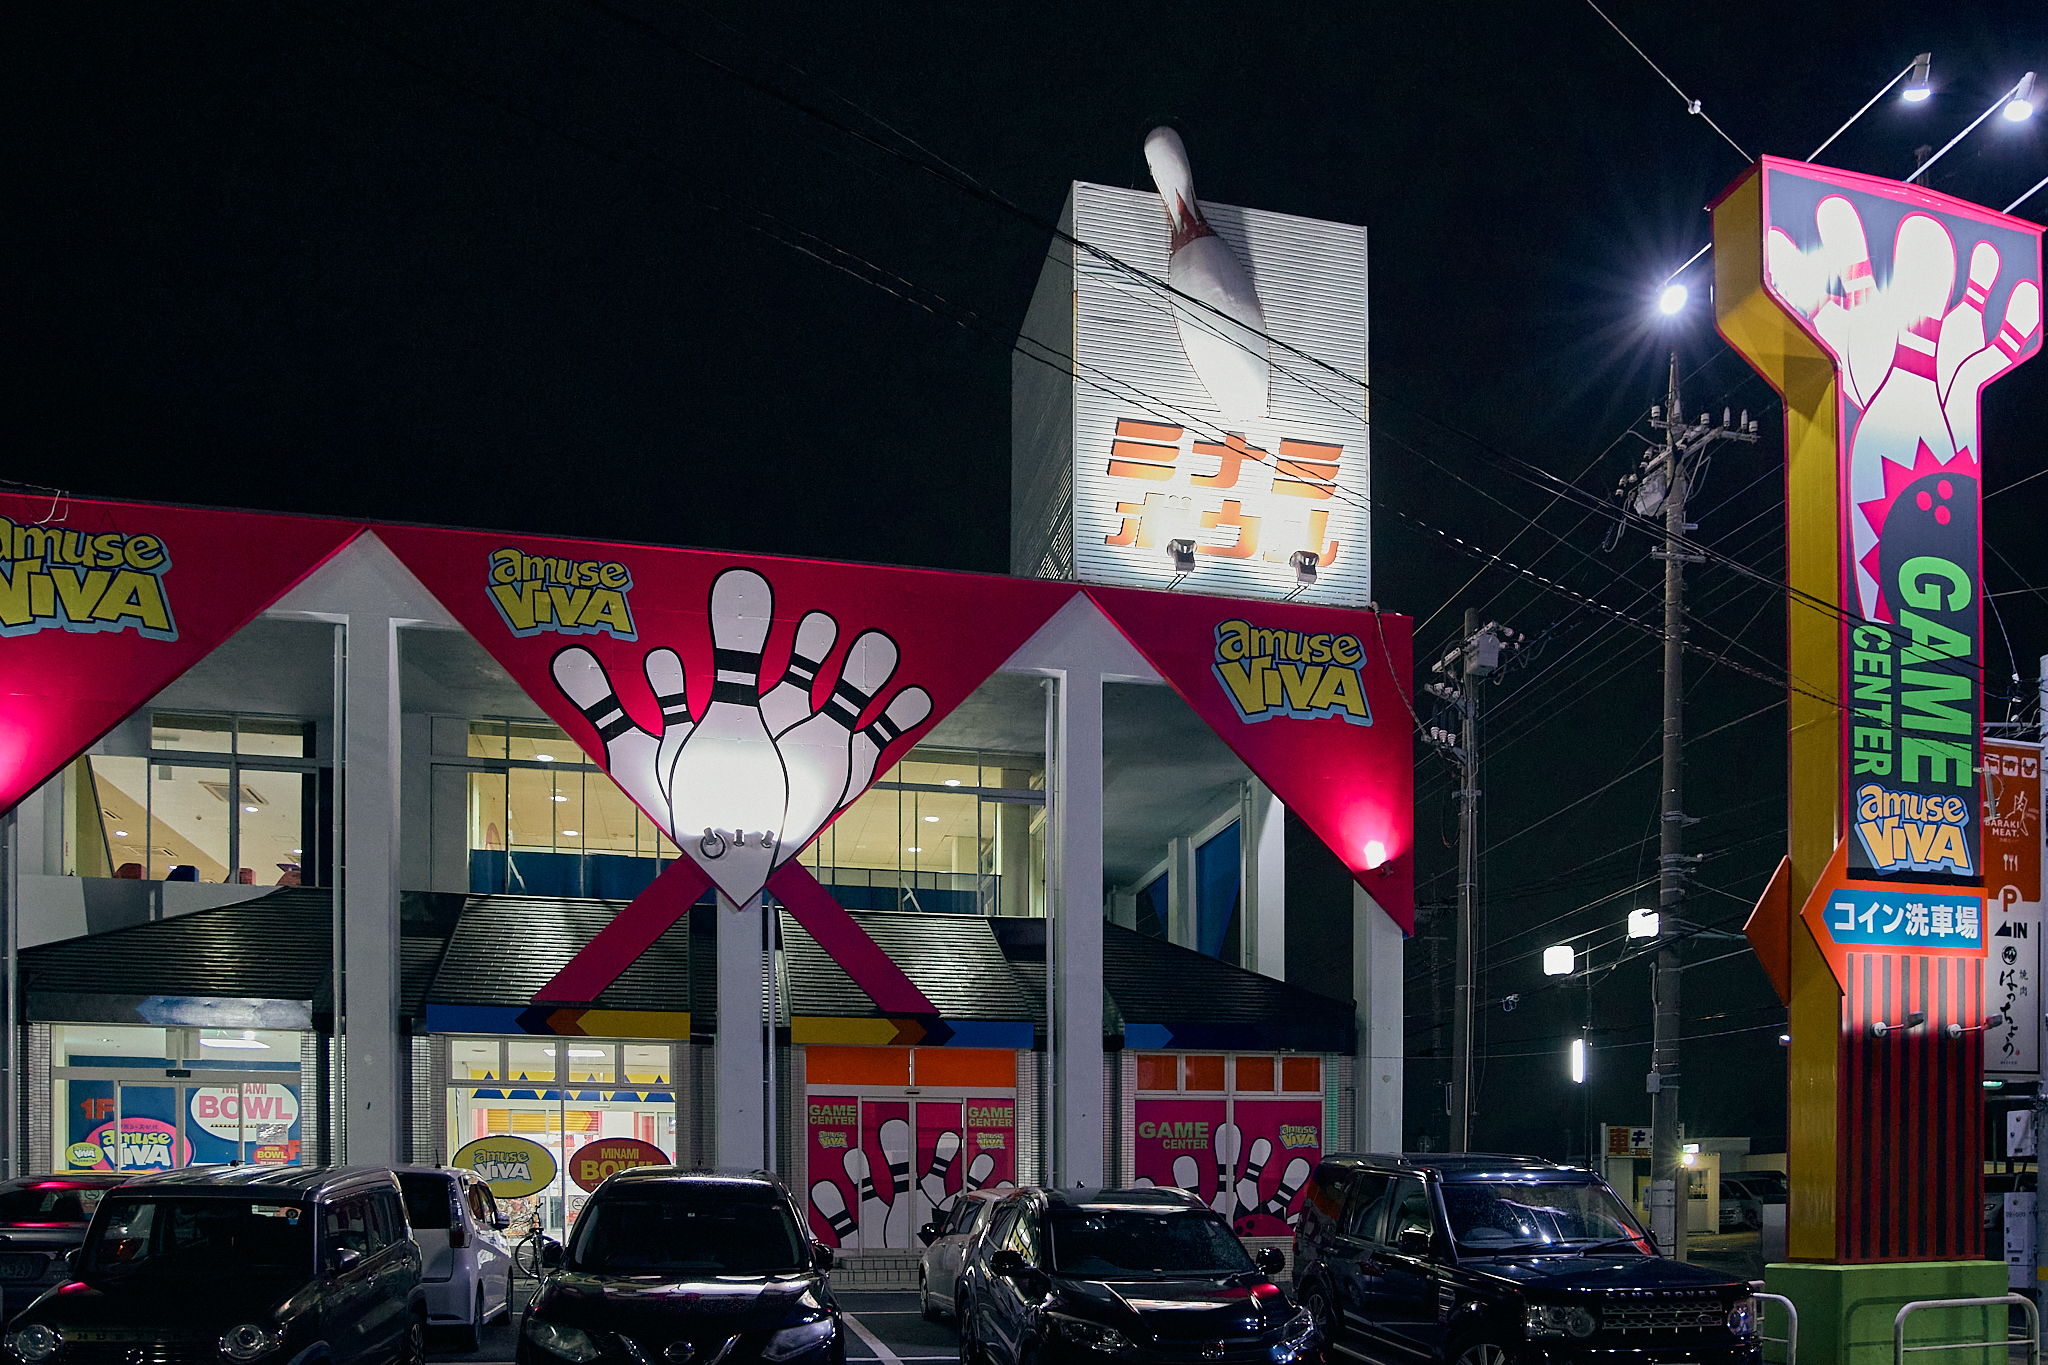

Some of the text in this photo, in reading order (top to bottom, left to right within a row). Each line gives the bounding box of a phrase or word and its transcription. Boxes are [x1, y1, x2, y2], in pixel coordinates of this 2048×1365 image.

[1107, 417, 1343, 500] ミナミ
[491, 547, 630, 590] amuse
[1218, 619, 1364, 665] amuse
[1898, 556, 1972, 787] GAME
[1853, 625, 1892, 776] CENTER
[1859, 783, 1966, 824] amuse
[1992, 827, 2019, 837] MEAT.
[2003, 888, 2017, 912] P
[1834, 901, 1979, 939] コイン洗車場
[2013, 922, 2028, 939] IN
[2019, 969, 2028, 997] 焼肉
[1999, 968, 2019, 1059] はっちょう
[199, 1096, 293, 1120] BOWL
[809, 1104, 857, 1116] GAME
[967, 1106, 1014, 1118] GAME
[810, 1116, 856, 1125] CENTER
[968, 1118, 1013, 1127] CENTER
[102, 1130, 170, 1145] amuse
[1138, 1121, 1209, 1139] GAME
[601, 1148, 640, 1159] MINAMI
[1162, 1139, 1208, 1150] CENTER
[257, 1151, 288, 1159] BOWL
[475, 1149, 529, 1163] amuse
[580, 1160, 653, 1181] BO
[1606, 1290, 1718, 1299] LAND ROVER
